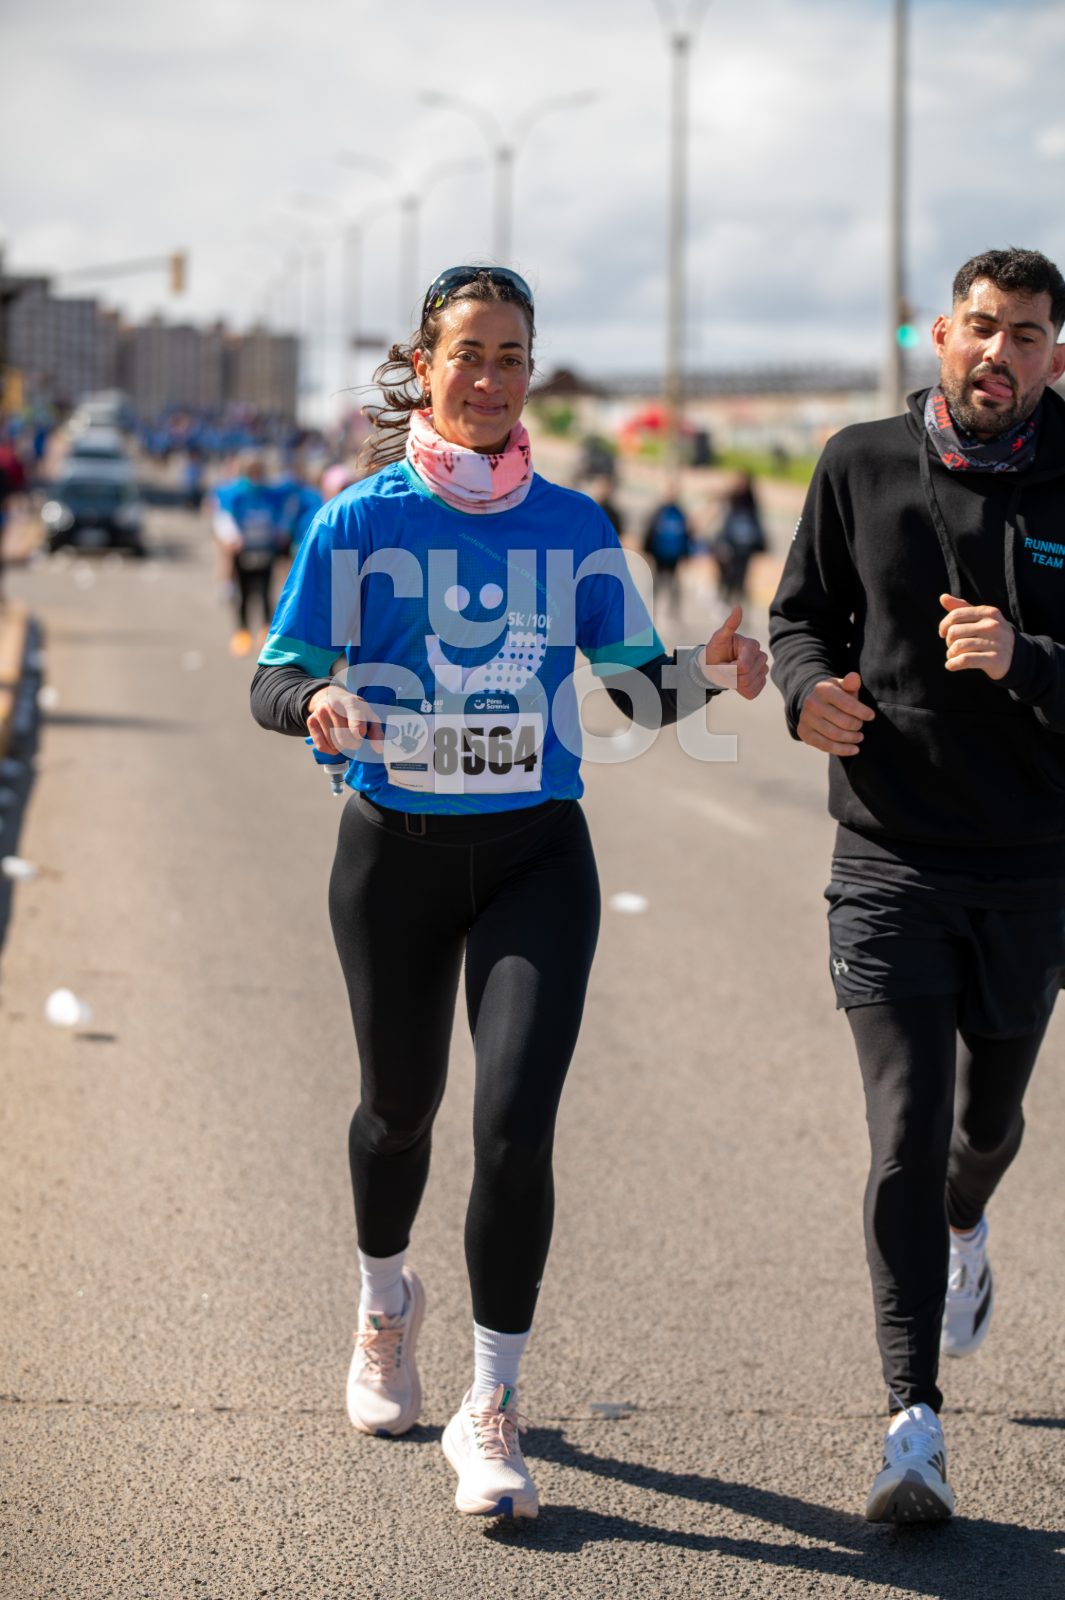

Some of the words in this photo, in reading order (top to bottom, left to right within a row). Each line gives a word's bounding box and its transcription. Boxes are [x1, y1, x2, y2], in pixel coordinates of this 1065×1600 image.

[933, 396, 952, 429] HALF
[1031, 552, 1064, 569] TEAM
[434, 726, 537, 775] 8564
